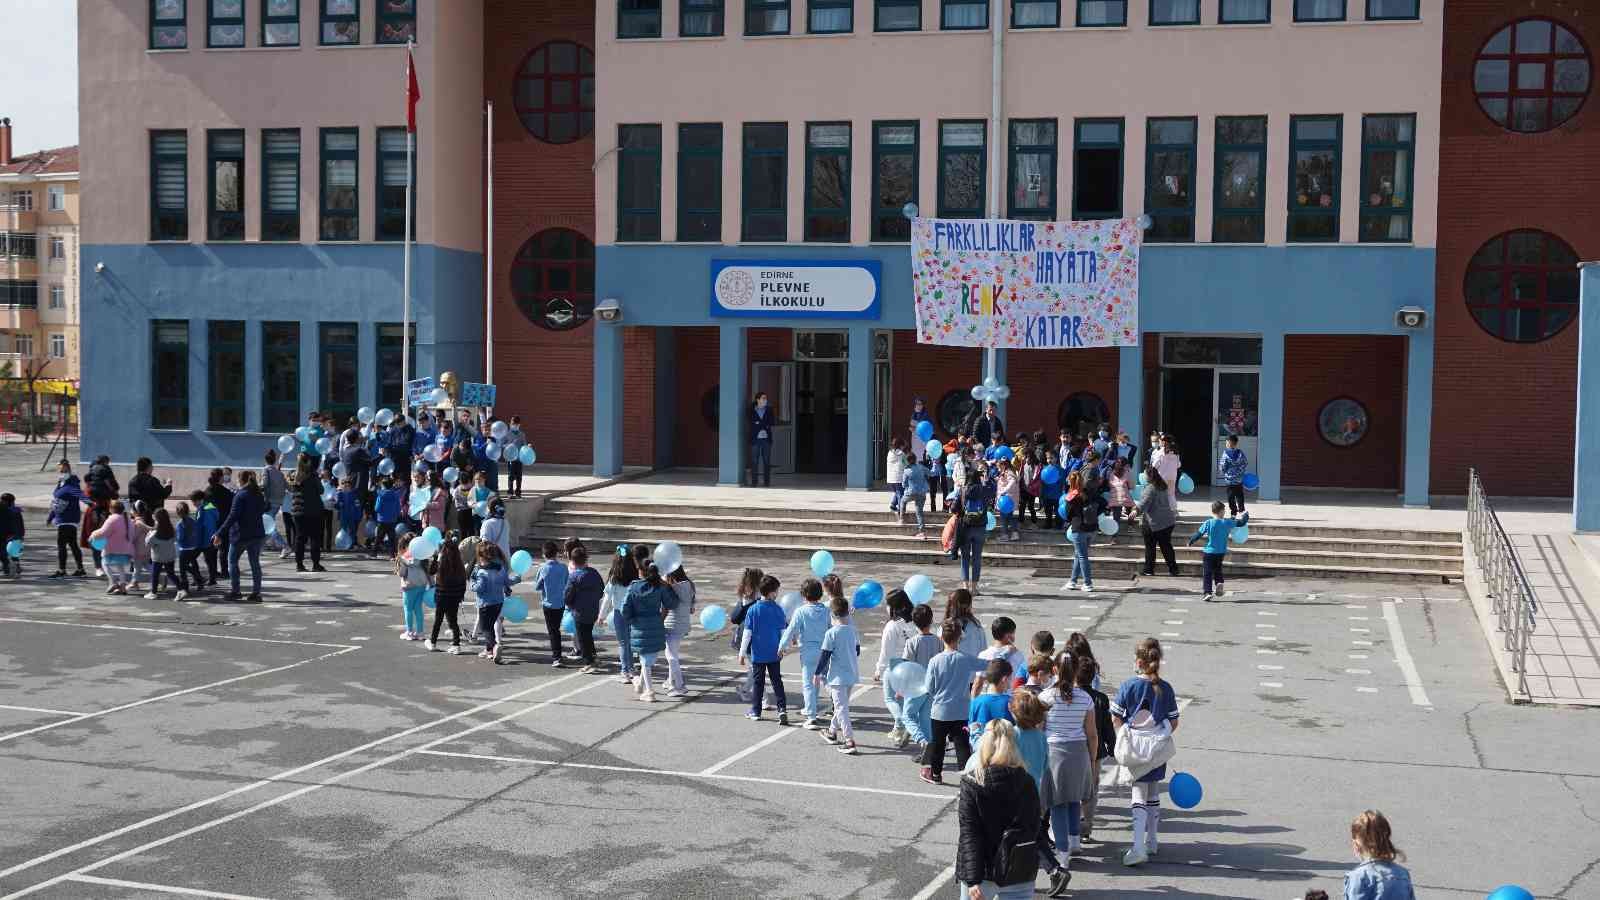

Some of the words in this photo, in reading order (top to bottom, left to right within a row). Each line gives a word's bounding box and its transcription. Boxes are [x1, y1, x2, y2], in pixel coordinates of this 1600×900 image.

[934, 222, 1036, 251] FARKLILIKLAR
[1035, 250, 1097, 284] HAYATA
[760, 282, 811, 293] PLEVNE
[760, 294, 825, 307] İLKOKULU
[961, 283, 1003, 316] RENK
[1026, 315, 1084, 348] KATAR
